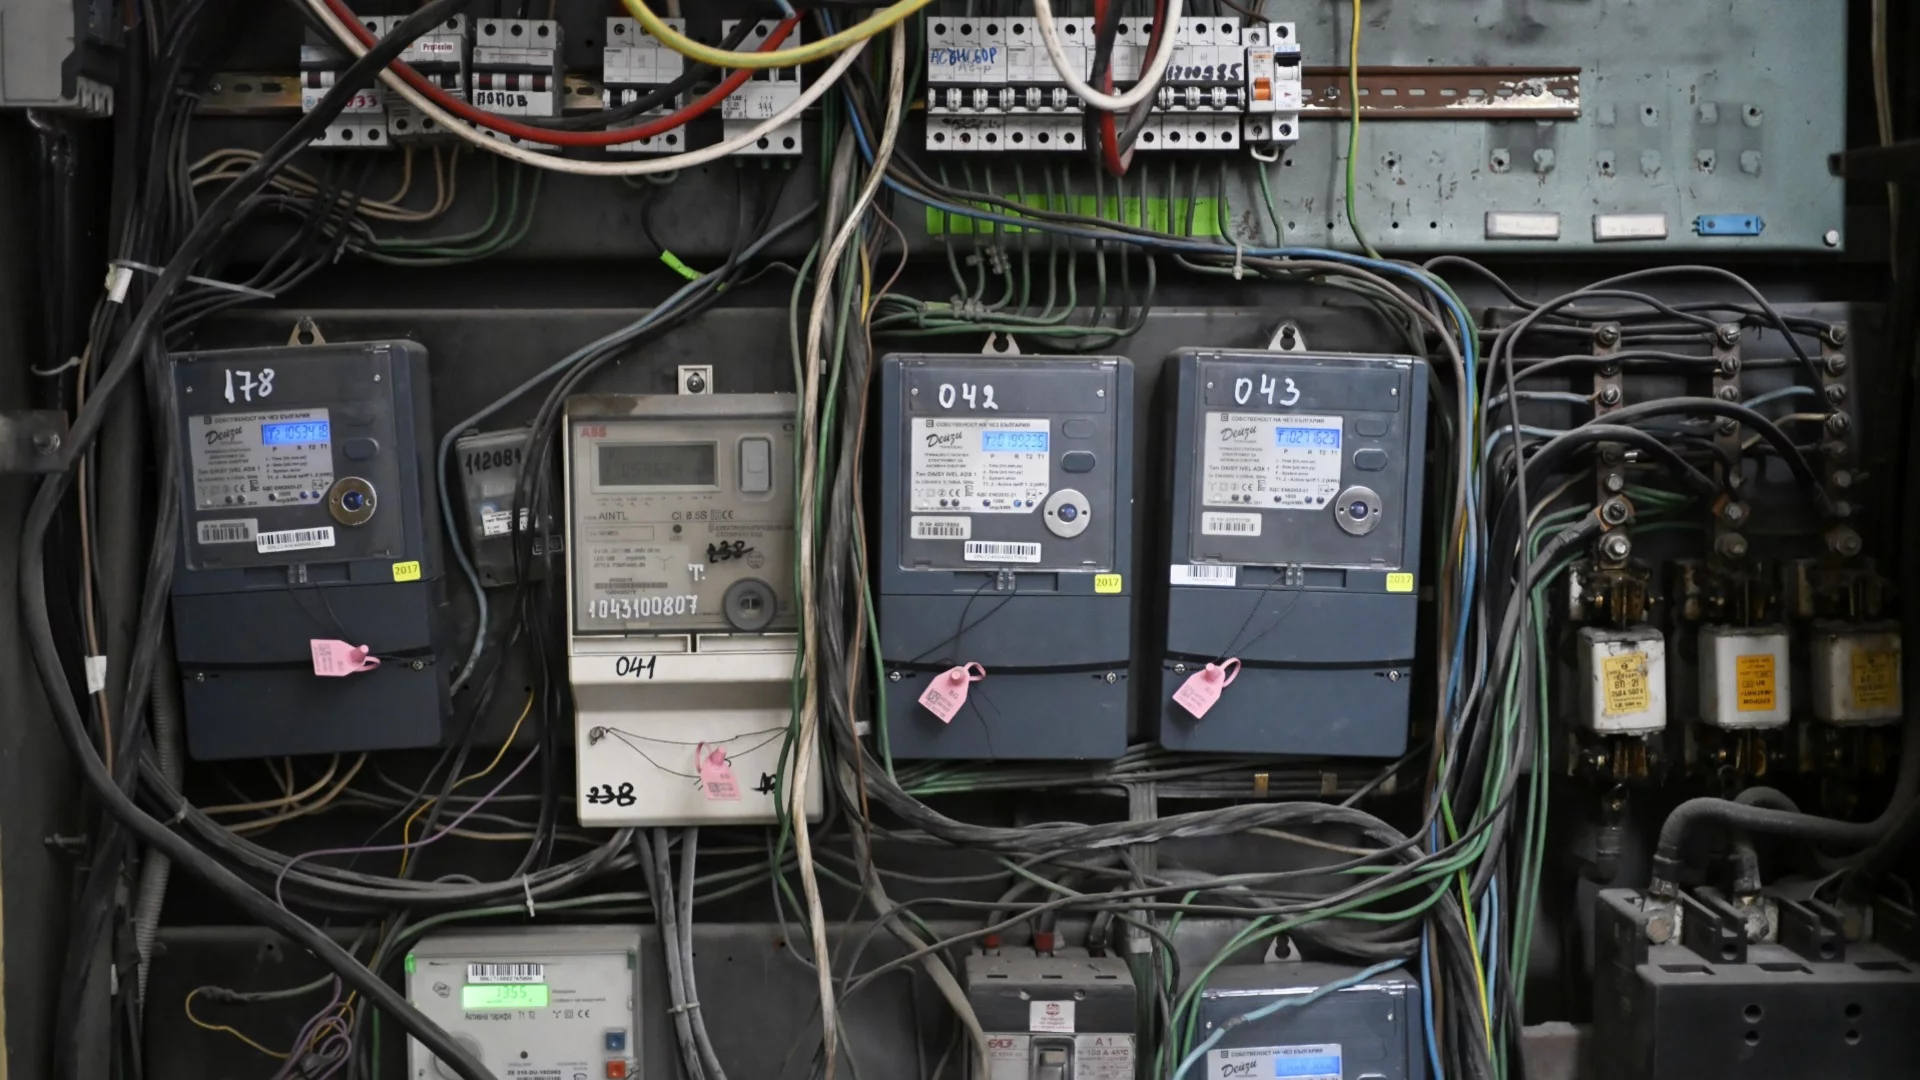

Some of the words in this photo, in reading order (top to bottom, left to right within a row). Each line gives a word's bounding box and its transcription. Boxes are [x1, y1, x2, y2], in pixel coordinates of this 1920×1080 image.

[224, 368, 275, 404] 178
[938, 383, 999, 410] 042
[1234, 374, 1300, 407] 043
[581, 426, 607, 438] ABB
[394, 564, 418, 576] 2017
[1096, 578, 1119, 587] 2017
[588, 595, 698, 620] 1043100807
[616, 655, 657, 679] 041
